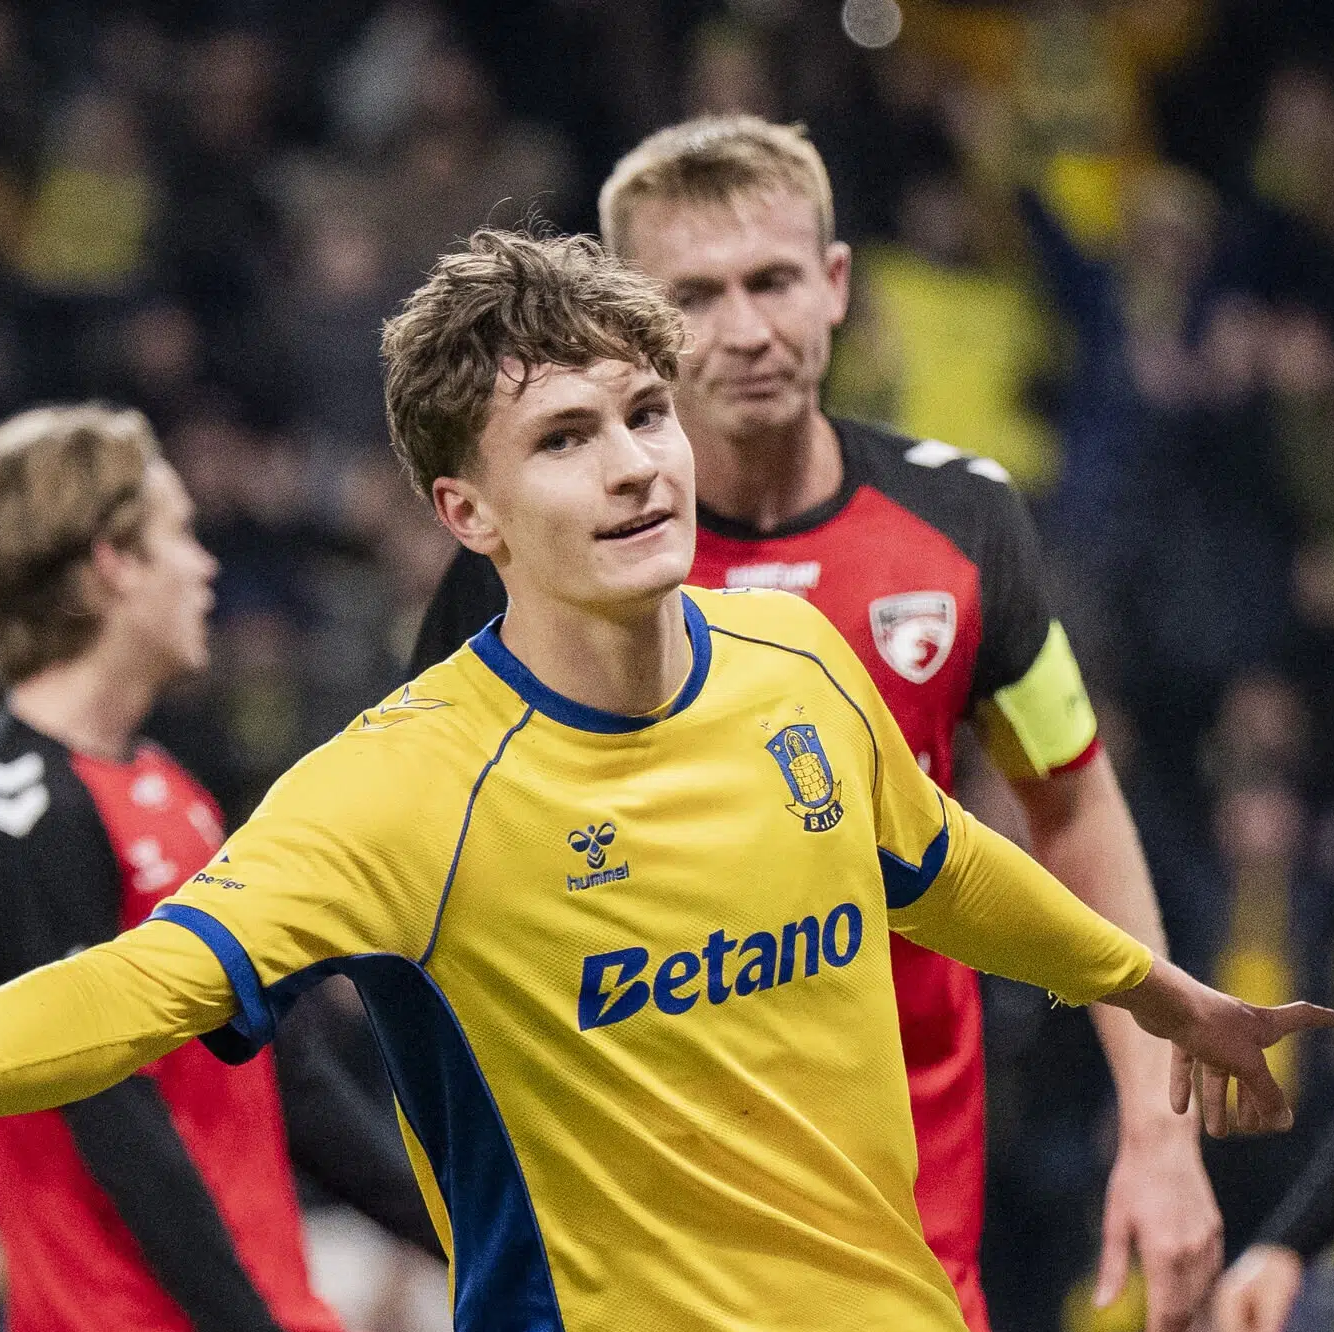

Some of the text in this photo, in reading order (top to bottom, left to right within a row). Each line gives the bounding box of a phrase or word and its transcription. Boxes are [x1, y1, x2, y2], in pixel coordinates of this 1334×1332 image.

[192, 872, 247, 890] perliga
[567, 860, 630, 892] hummel
[577, 902, 863, 1032] Betano
